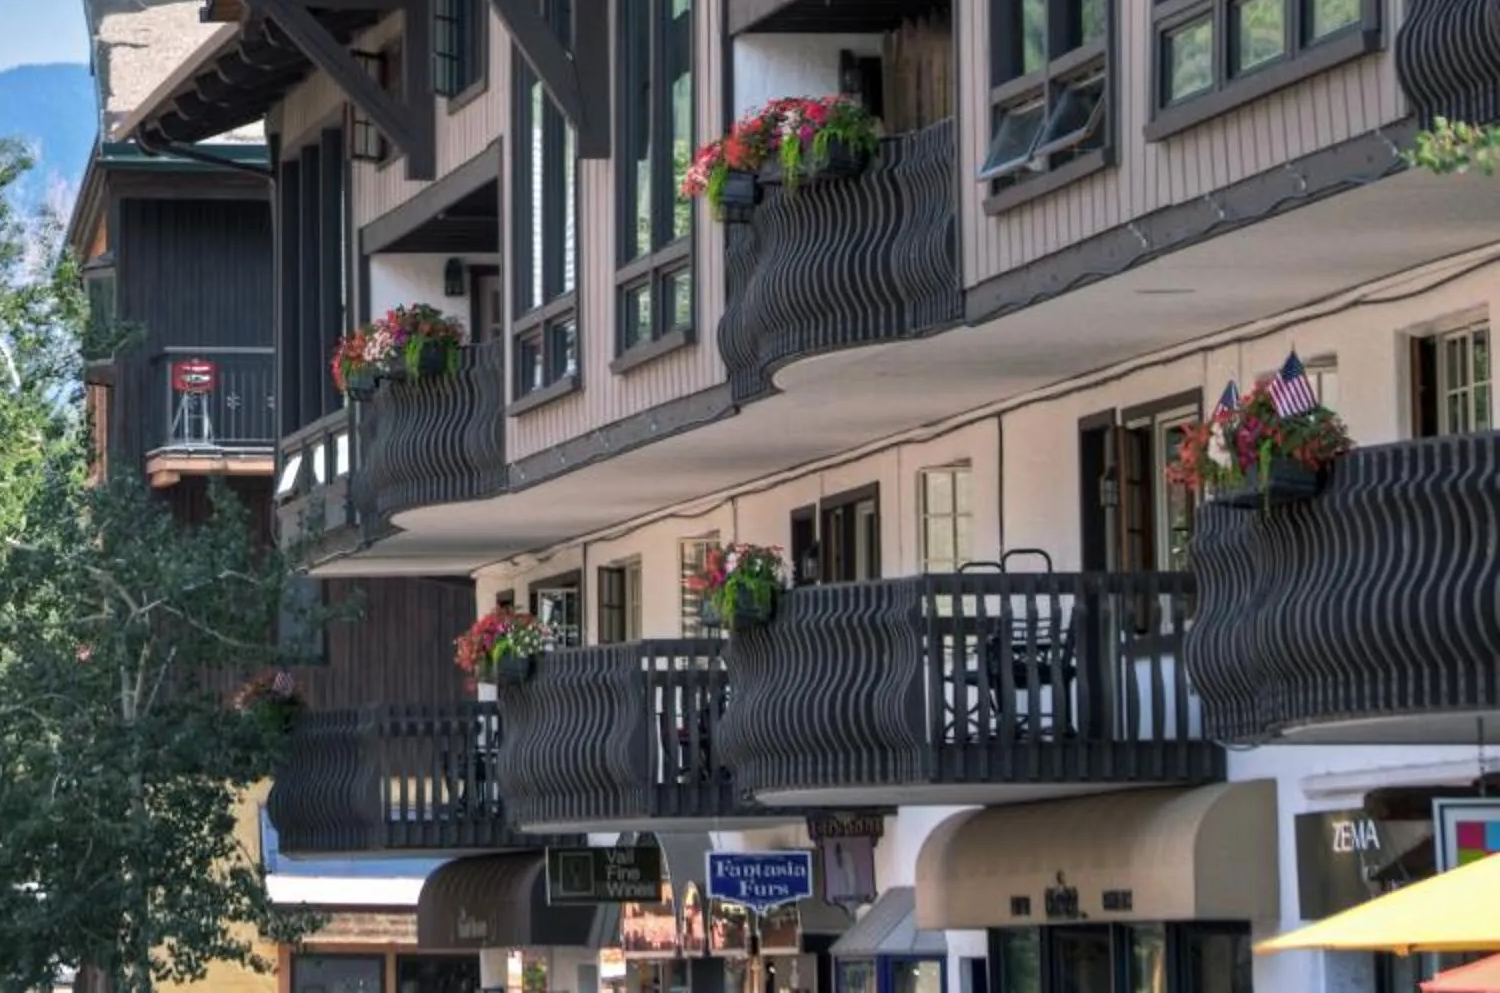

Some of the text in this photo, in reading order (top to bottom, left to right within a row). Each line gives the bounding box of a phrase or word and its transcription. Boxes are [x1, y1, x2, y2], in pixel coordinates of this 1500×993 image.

[605, 865, 641, 881] Fine
[715, 860, 807, 878] Fantasia
[739, 880, 790, 896] Furs
